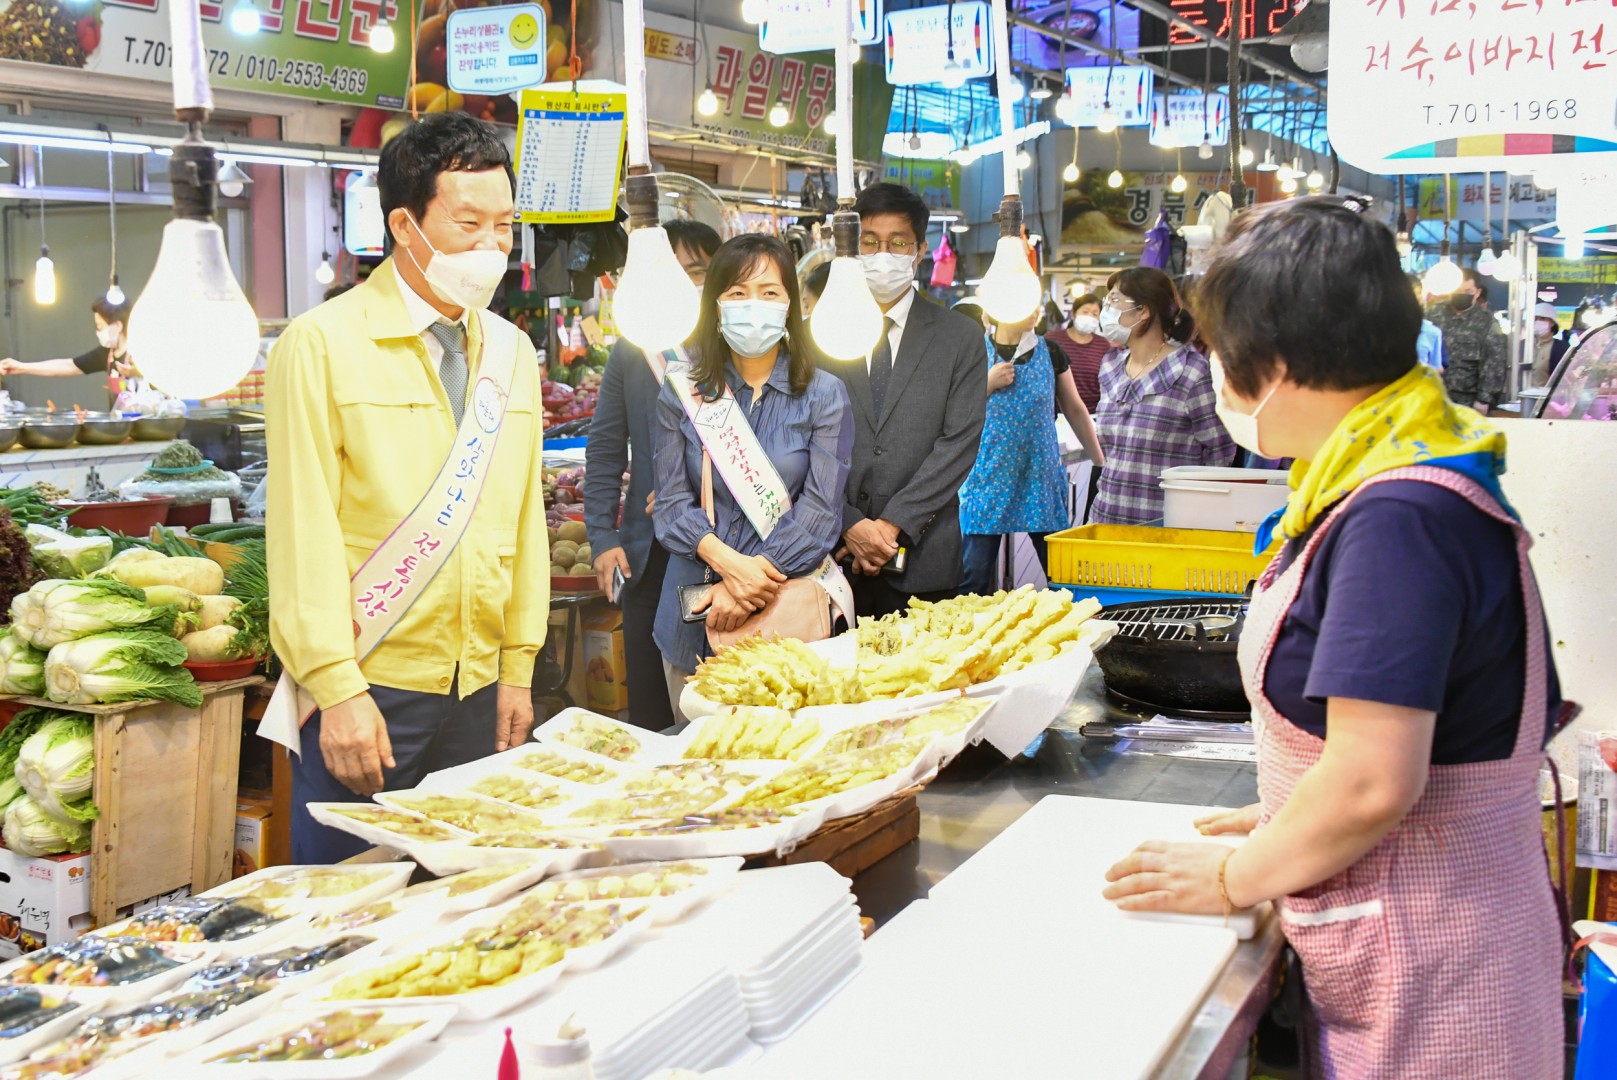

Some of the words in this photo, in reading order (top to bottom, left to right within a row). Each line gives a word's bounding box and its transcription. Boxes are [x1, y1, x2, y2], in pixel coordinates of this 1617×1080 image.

[246, 55, 367, 93] 010-2553-4369
[712, 45, 835, 128] 과일마당
[1422, 99, 1578, 126] T.701-1968
[357, 531, 441, 620] 전통시장
